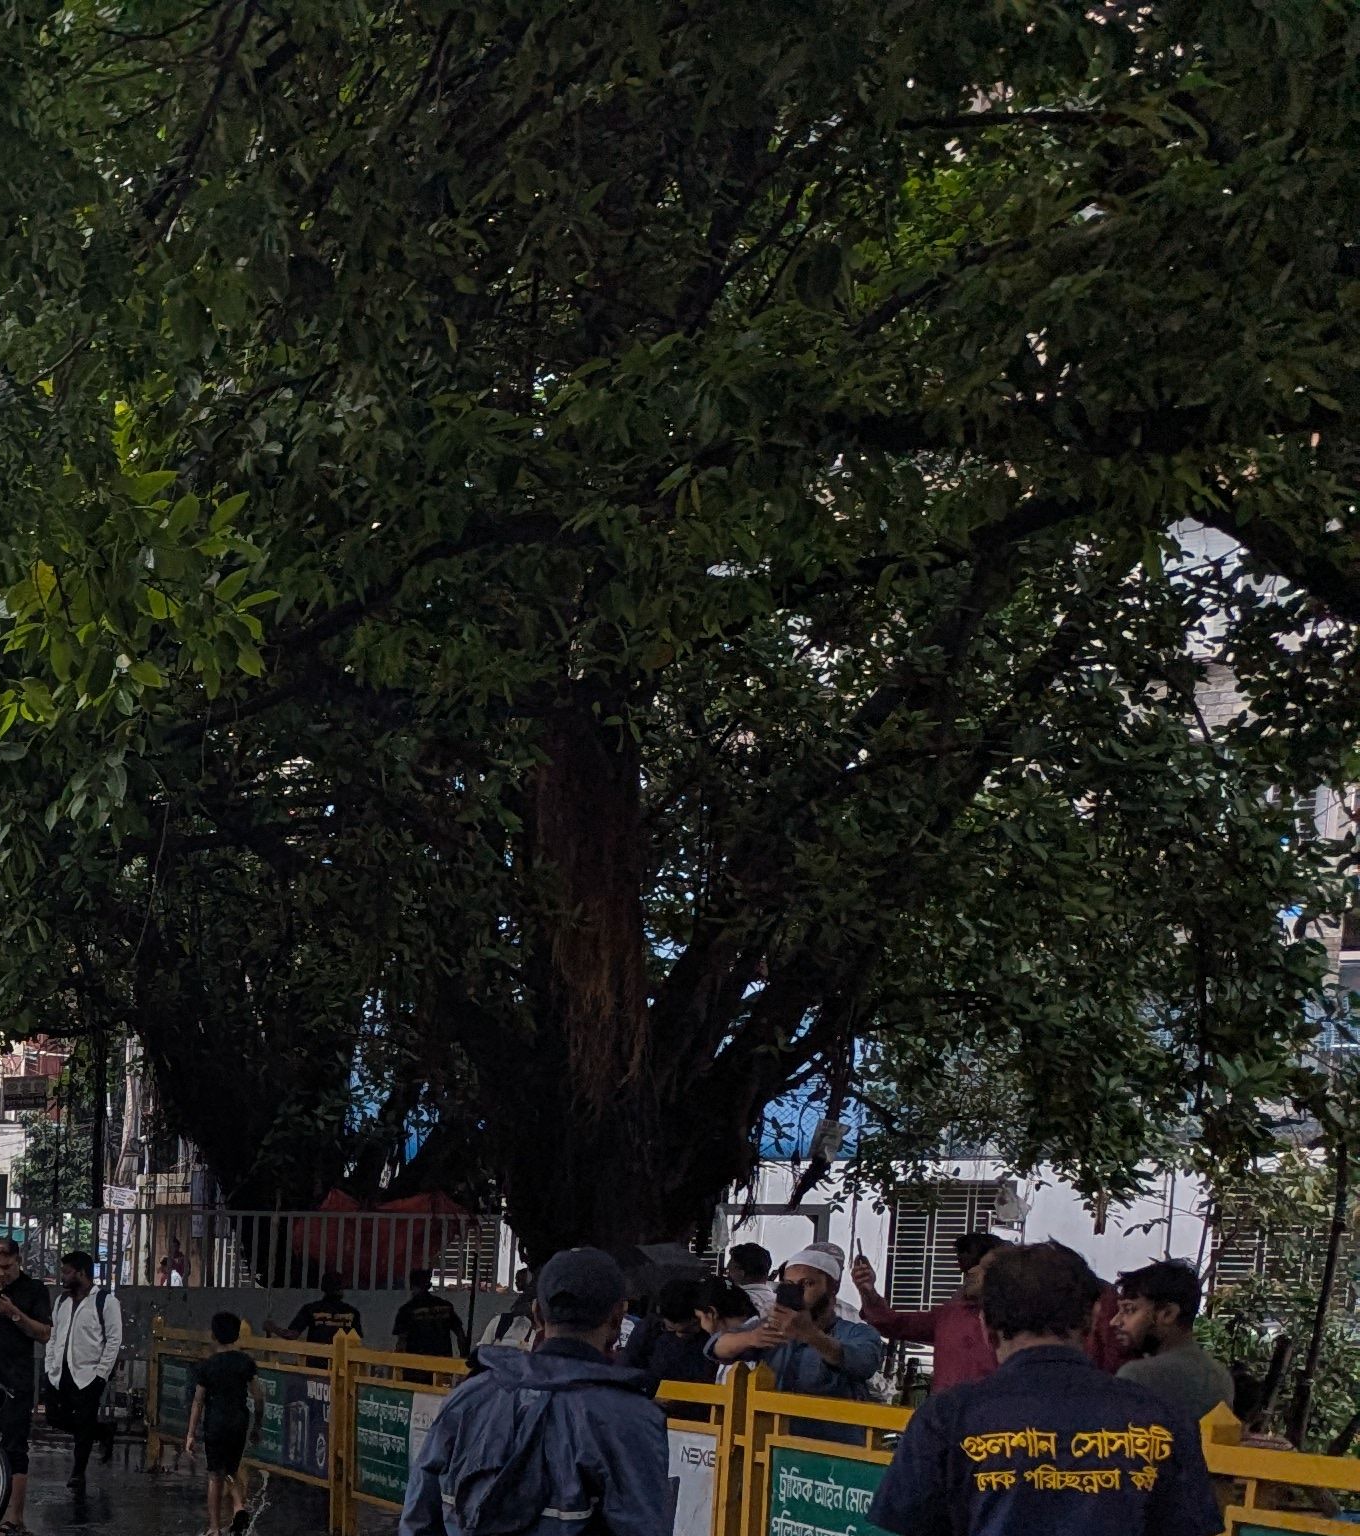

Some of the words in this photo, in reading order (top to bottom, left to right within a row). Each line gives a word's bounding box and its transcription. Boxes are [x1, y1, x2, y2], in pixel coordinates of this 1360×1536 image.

[960, 1427, 1058, 1461] গুলশান
[1071, 1421, 1174, 1464] সোসাইটি
[778, 1466, 814, 1504] ট্রাফিক
[814, 1476, 844, 1511] আইন
[974, 1469, 1017, 1491] লেক
[1024, 1464, 1121, 1494] পরিচ্ছন্নতা
